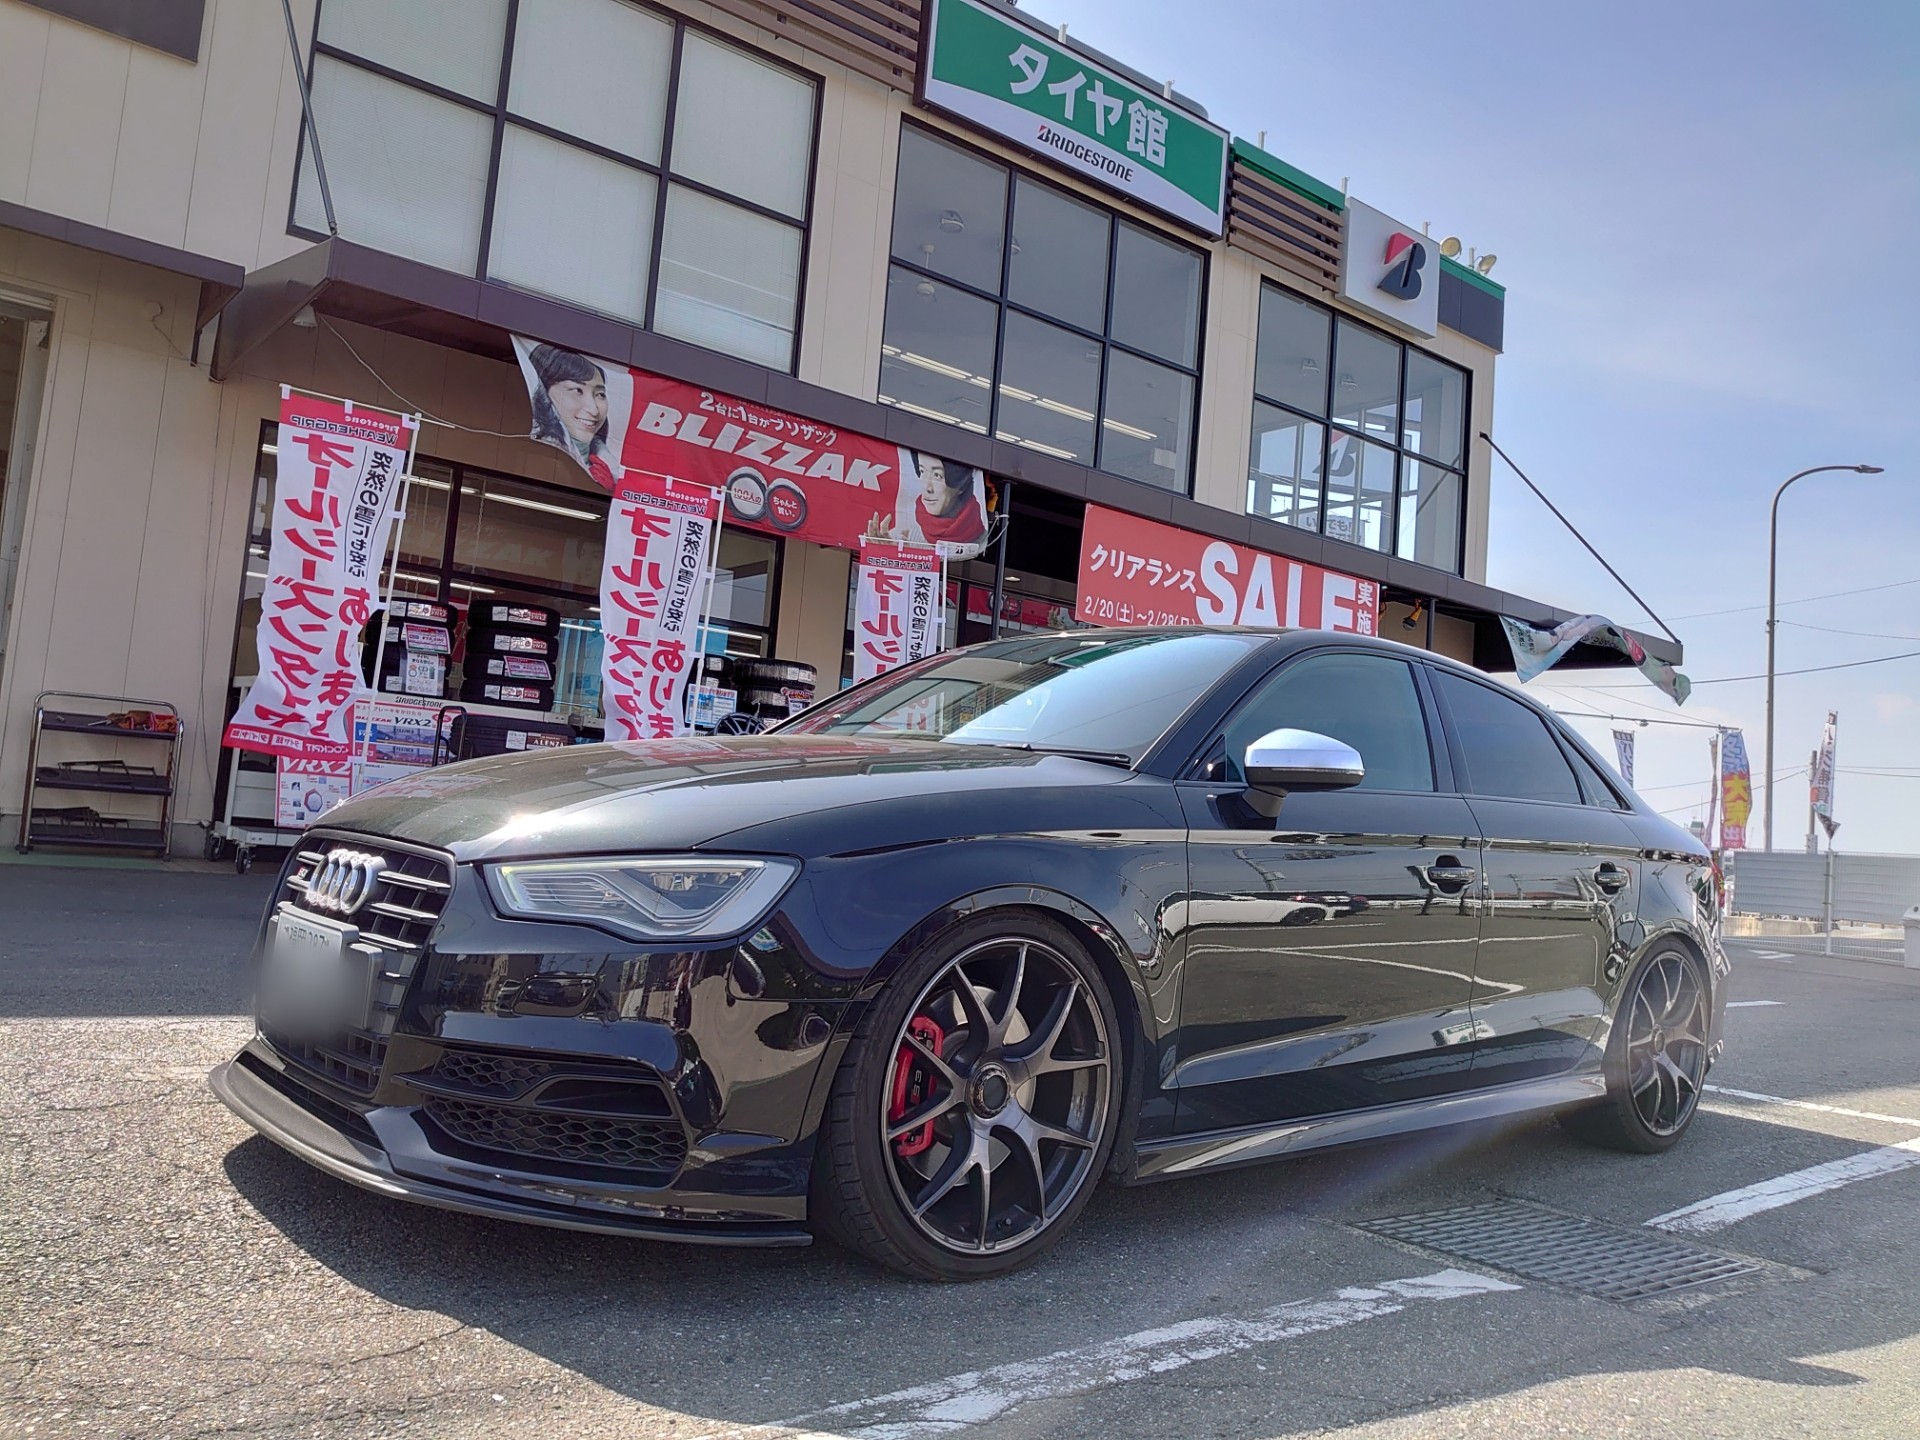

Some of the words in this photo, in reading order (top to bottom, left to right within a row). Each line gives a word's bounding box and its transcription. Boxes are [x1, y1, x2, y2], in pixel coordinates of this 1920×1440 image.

[1008, 42, 1169, 168] タイヤ館
[1036, 124, 1134, 183] BRIDGESTONE
[699, 391, 837, 447] 2台に1台がブリザック
[637, 401, 893, 493] BLIZZAK
[773, 496, 798, 509] ちゃんと
[1090, 544, 1198, 594] クリアランス
[1195, 541, 1357, 630] SALE
[1356, 581, 1374, 635] 実施
[394, 716, 432, 728] VRX2
[395, 696, 444, 708] BRIDGESTONE
[280, 755, 352, 776] VRX2
[533, 739, 564, 747] ALENZA
[913, 1069, 922, 1097] S3
